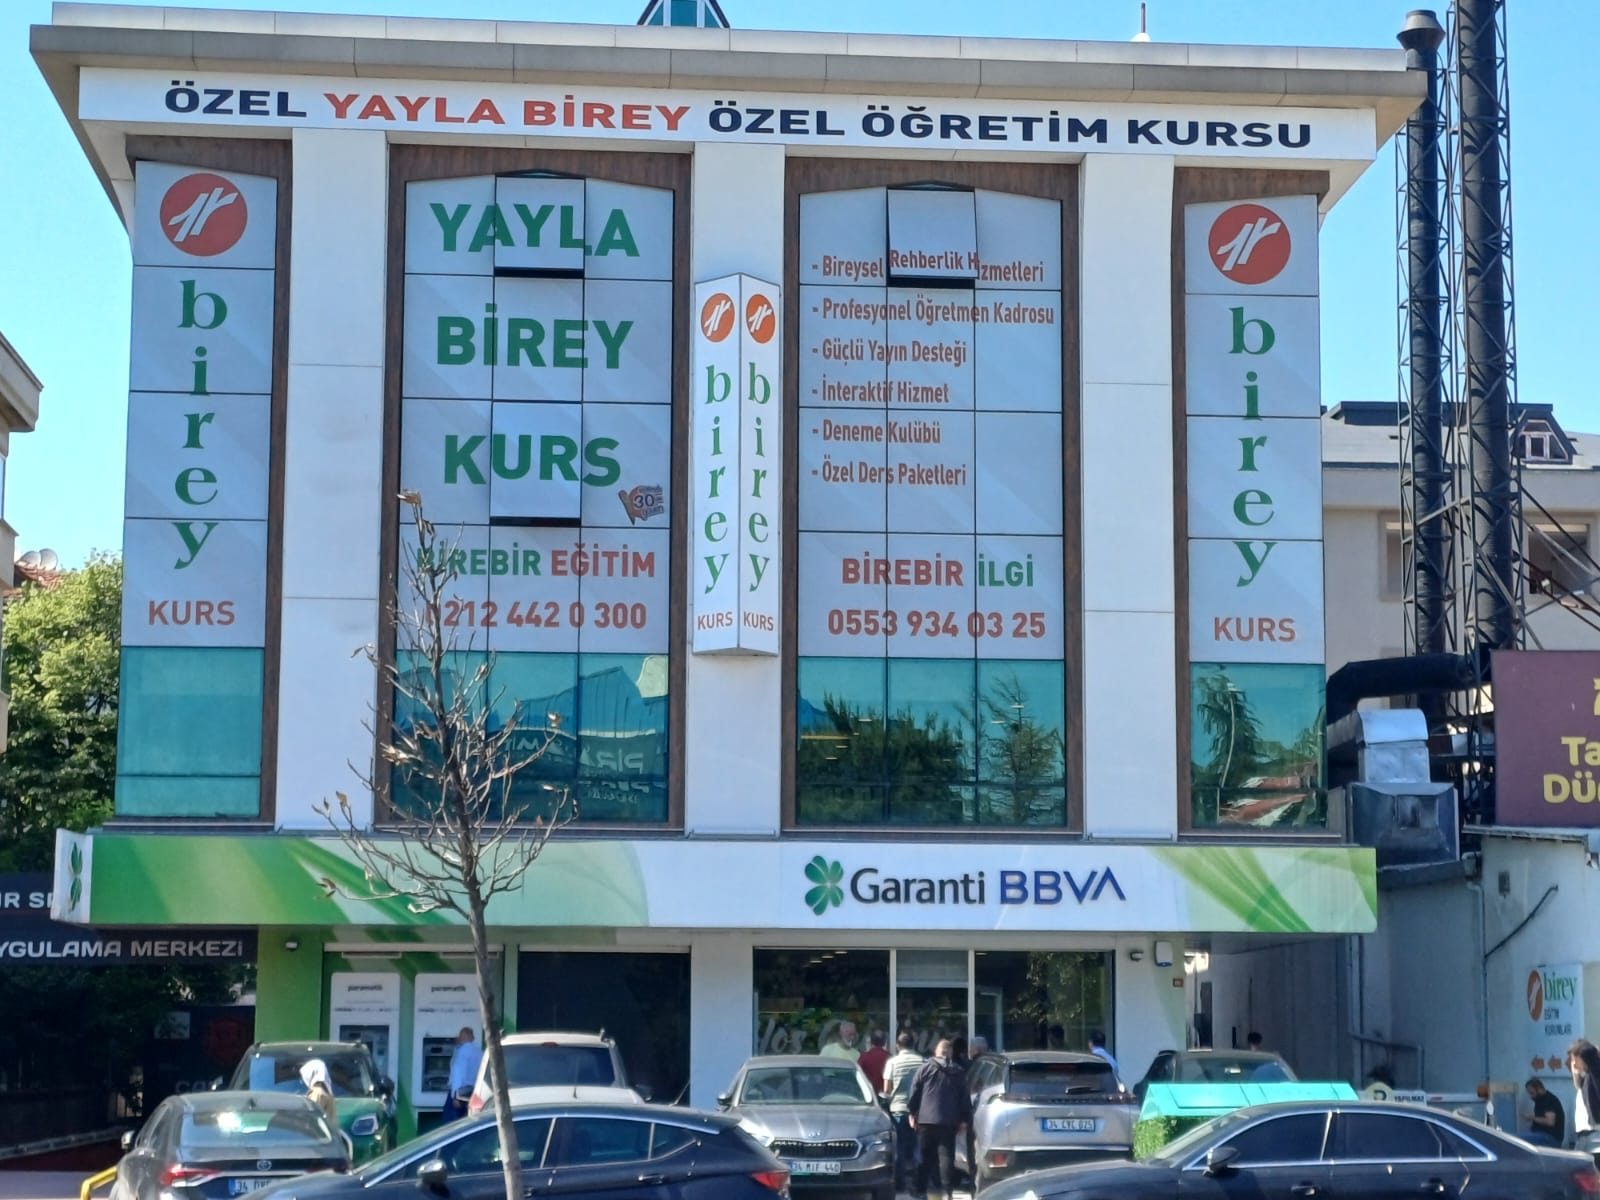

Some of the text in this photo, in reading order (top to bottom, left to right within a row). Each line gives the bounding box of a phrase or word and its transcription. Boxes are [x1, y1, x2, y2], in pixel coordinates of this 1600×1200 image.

[165, 80, 1311, 149] ÖZEL YAYLA BİREY ÖZEL ÖĞRETİM KURSU
[429, 203, 641, 257] YAYLA
[822, 255, 884, 281] Bireysel
[889, 250, 963, 270] Rehberlik
[968, 251, 1044, 282] Hzmetleri
[823, 298, 911, 325] Profesyonel
[915, 294, 989, 326] Öğretmen
[994, 302, 1054, 324] Kadrosu
[437, 303, 634, 369] BİREY
[822, 338, 864, 366] Güçlü
[869, 340, 908, 367] Yayın
[911, 340, 967, 366] Desteği
[822, 374, 894, 402] İnteraktif
[898, 382, 950, 403] Hizmet
[823, 419, 883, 441] Deneme
[888, 421, 941, 444] Kulübü
[444, 434, 621, 487] KURS
[822, 455, 854, 482] Özel
[858, 461, 894, 483] Ders
[898, 463, 967, 486] Paketleri
[634, 494, 655, 509] 30
[551, 543, 655, 577] EĞİTİM
[842, 551, 1034, 587] BİREBİR İLGİ
[148, 600, 236, 625] KURS
[506, 601, 560, 628] 442
[569, 602, 585, 628] 0
[594, 602, 647, 629] 300
[697, 611, 734, 632] KURS
[743, 611, 775, 632] KURS
[828, 609, 1046, 638] 0553 934 03 25
[1214, 616, 1297, 642] KURS
[1543, 770, 1600, 804] Dü
[850, 866, 1127, 905] Garanti BBVA
[131, 941, 243, 957] MERKEZİ
[1543, 972, 1577, 1006] birey
